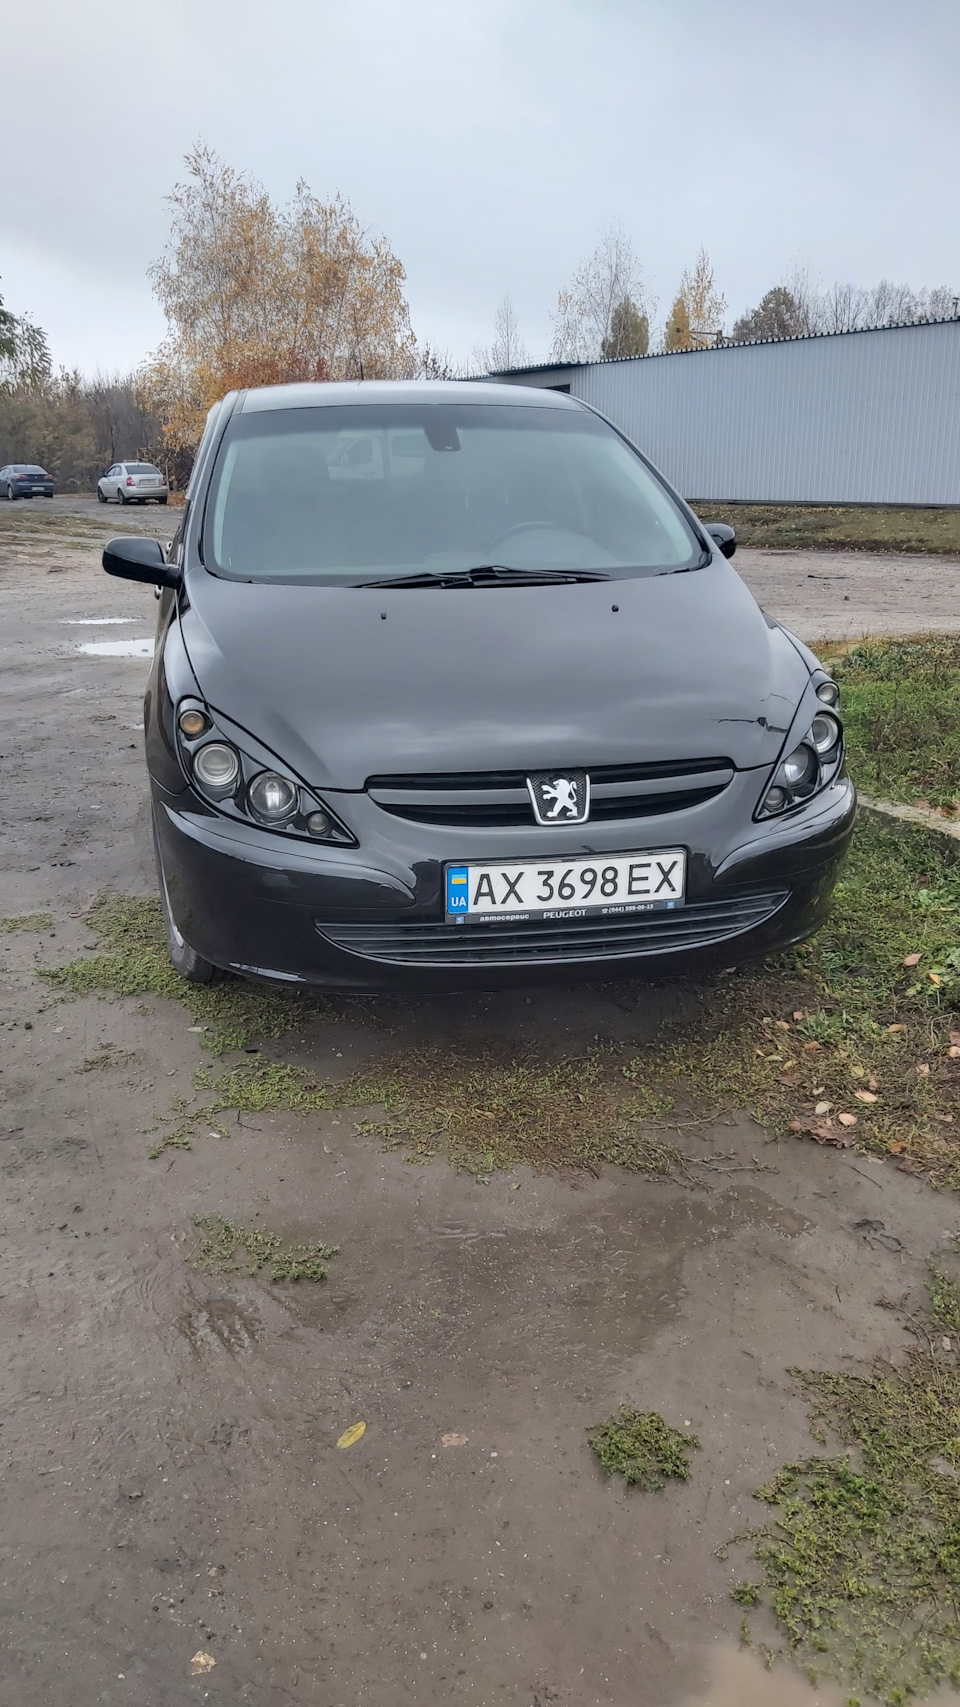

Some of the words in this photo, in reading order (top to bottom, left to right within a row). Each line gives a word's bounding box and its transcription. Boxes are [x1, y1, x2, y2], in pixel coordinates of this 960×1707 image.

[473, 872, 524, 905] AX
[536, 866, 619, 901] 3698
[627, 861, 678, 895] EX
[451, 896, 467, 907] UA
[543, 909, 587, 919] PEUGEOT
